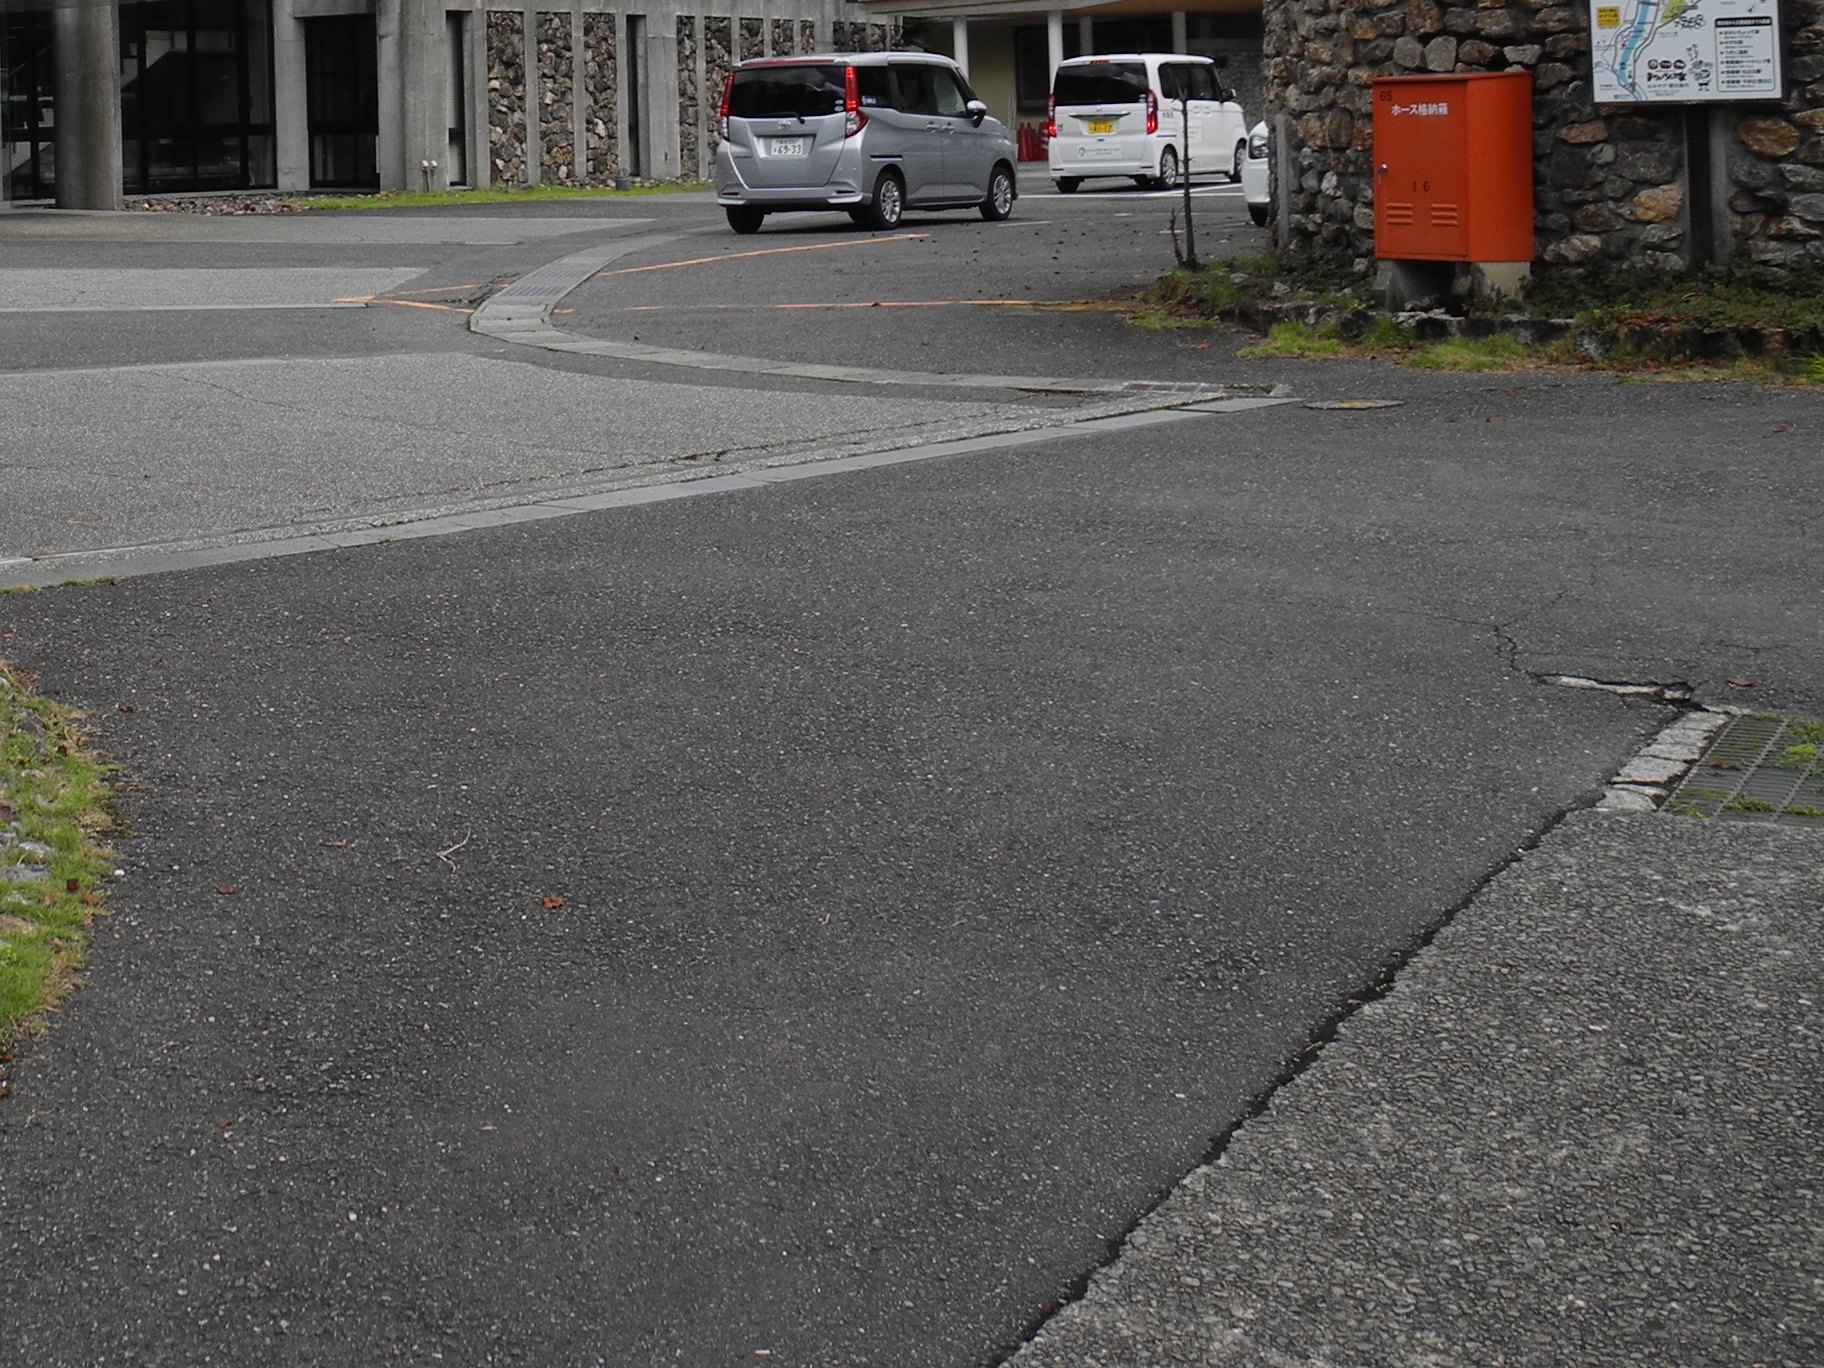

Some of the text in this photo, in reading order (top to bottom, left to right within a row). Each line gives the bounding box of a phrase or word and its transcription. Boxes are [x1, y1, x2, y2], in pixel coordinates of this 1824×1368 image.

[1390, 102, 1449, 116] ホース格納箱
